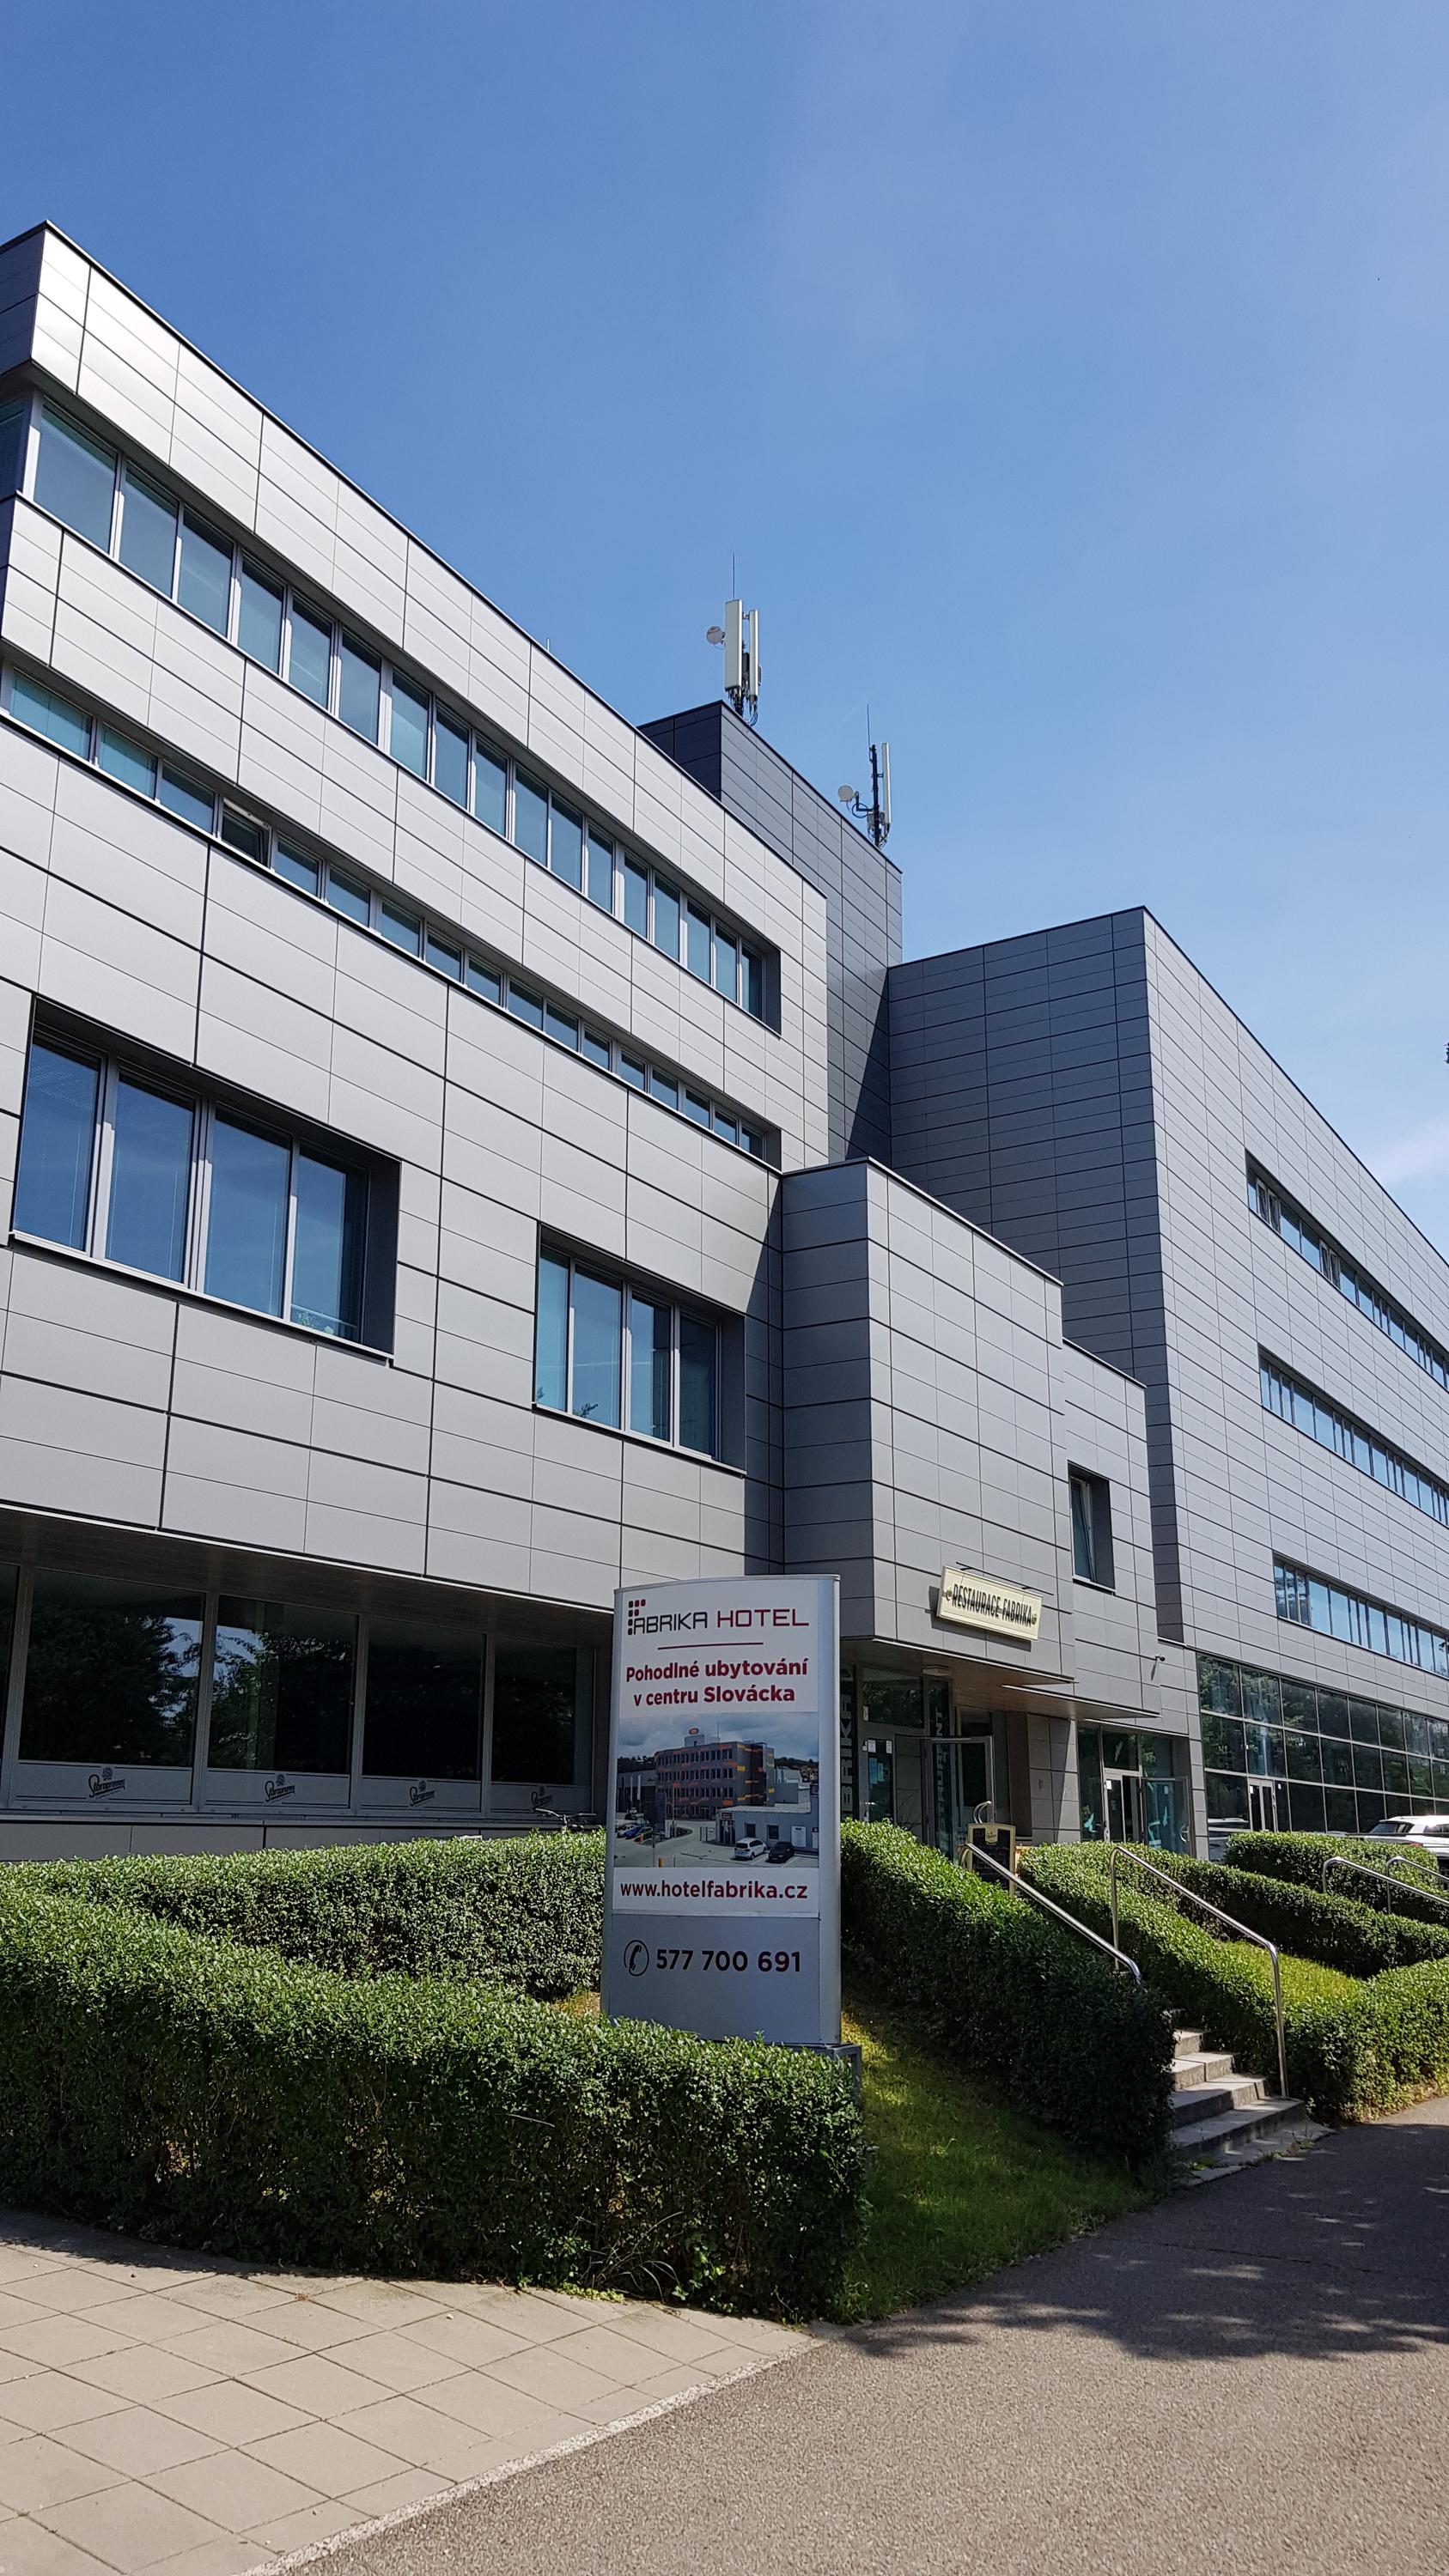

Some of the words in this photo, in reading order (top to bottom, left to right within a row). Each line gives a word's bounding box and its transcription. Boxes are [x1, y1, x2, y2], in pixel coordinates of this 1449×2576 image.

[952, 1584, 1001, 1619] RESTAURACE
[1002, 1599, 1032, 1627] FABRIKA
[717, 1608, 809, 1628] HOTEL
[626, 1661, 700, 1682] Pohodlné
[705, 1658, 809, 1679] ubytování
[634, 1694, 642, 1706] v
[646, 1688, 698, 1706] centru
[703, 1685, 795, 1703] Slovácka
[620, 1880, 808, 1899] www.hotelfabrika.cz
[656, 1949, 694, 1970] 577
[702, 1950, 748, 1971] 700
[758, 1951, 801, 1972] 691
